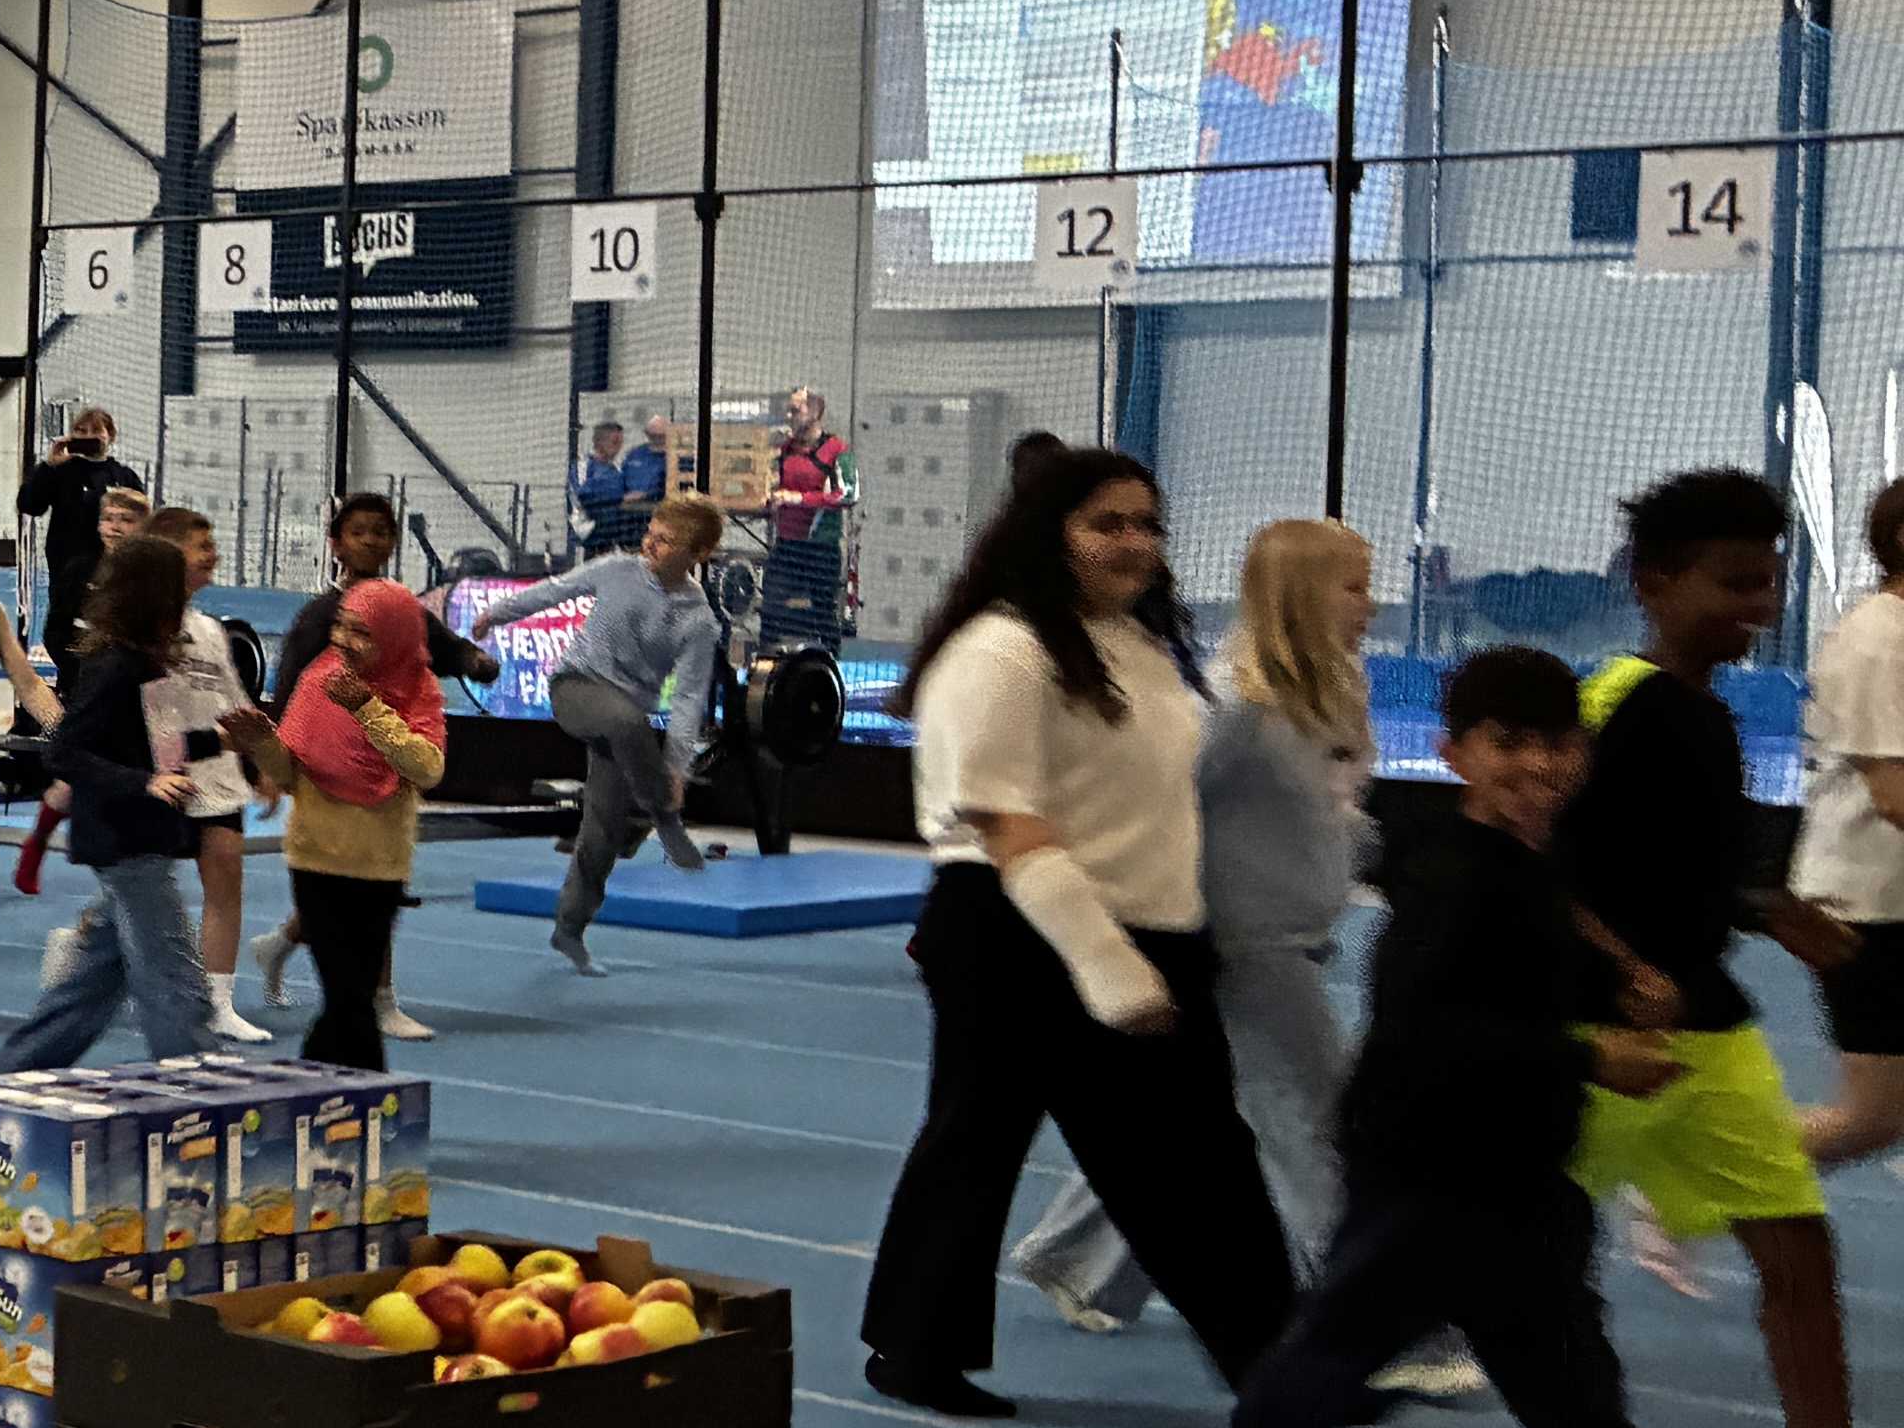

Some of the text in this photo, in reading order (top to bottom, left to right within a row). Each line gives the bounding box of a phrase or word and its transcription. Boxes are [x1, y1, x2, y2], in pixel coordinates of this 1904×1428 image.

[1667, 177, 1744, 236] 14
[590, 226, 639, 273] 10
[1056, 206, 1114, 257] 12
[88, 249, 109, 290] 6
[224, 244, 246, 285] 8
